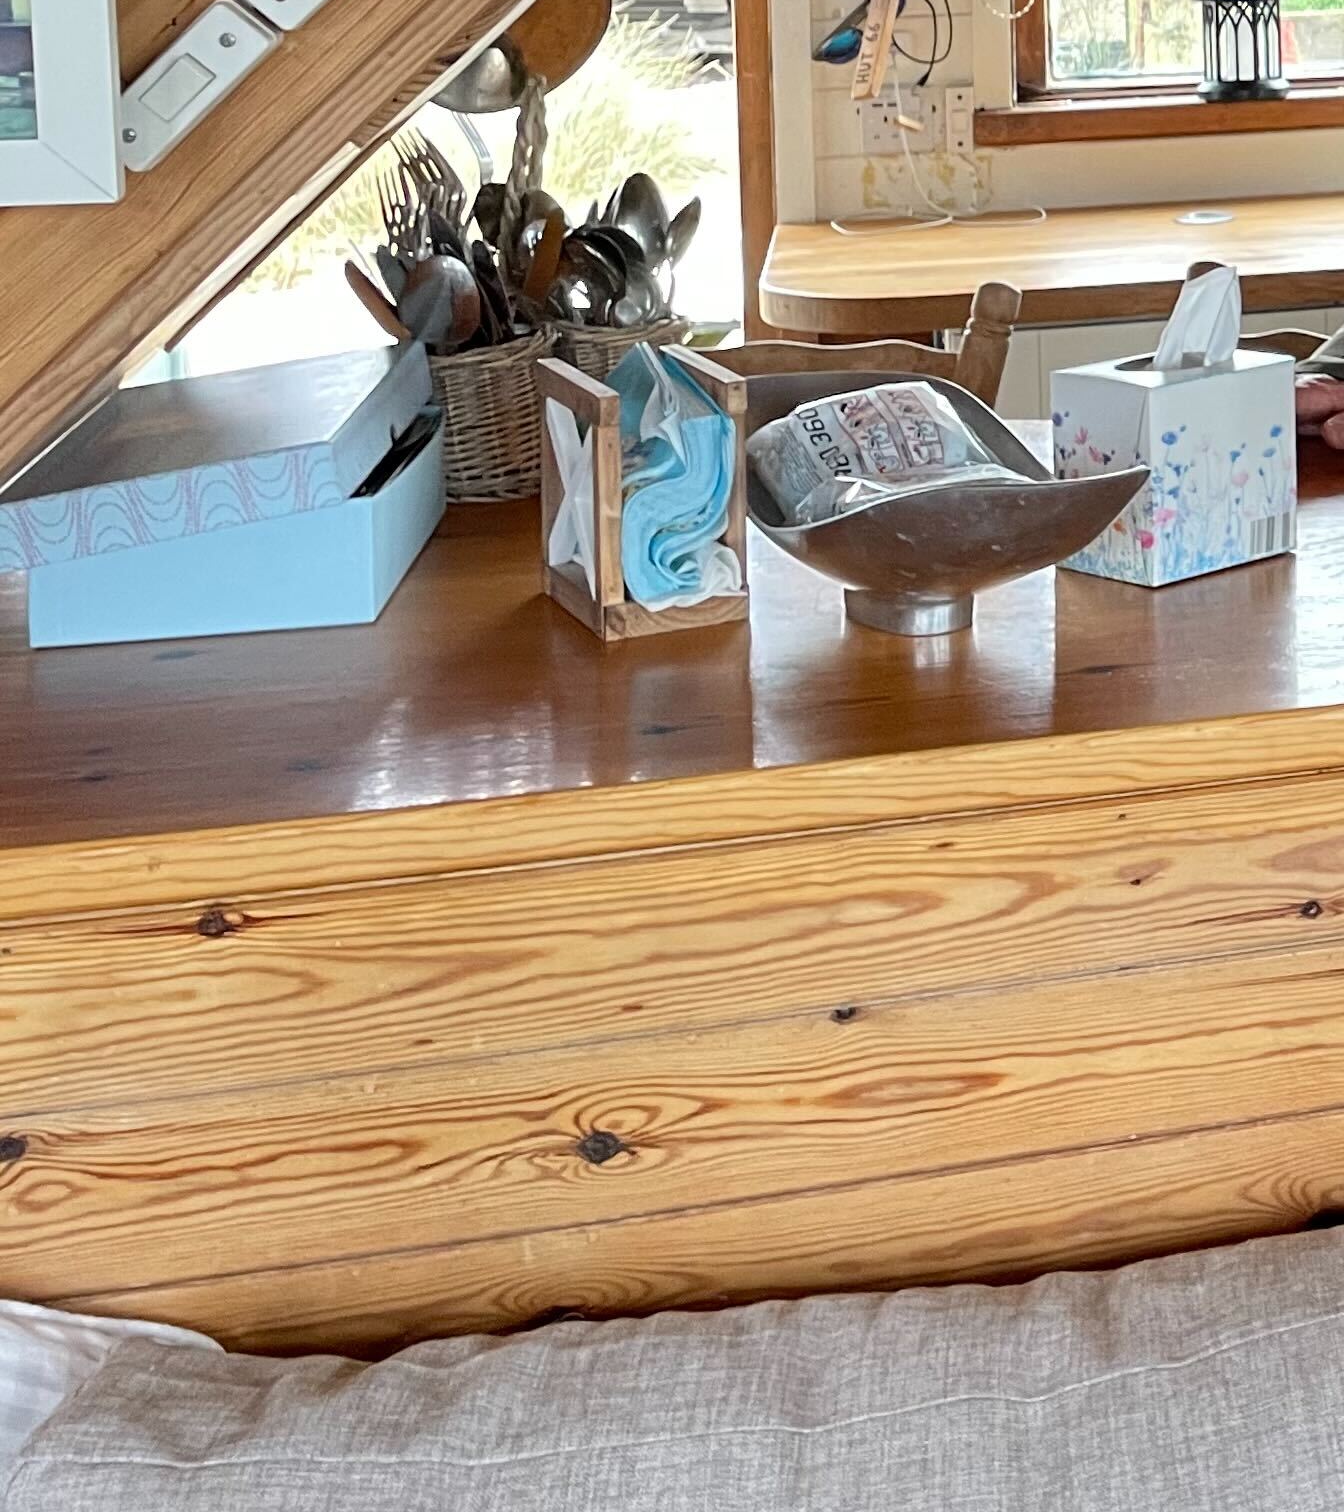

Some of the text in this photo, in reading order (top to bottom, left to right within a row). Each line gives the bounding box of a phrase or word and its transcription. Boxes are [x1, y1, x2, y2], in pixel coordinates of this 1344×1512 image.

[856, 23, 880, 83] HUT 66
[794, 407, 832, 446] 360
